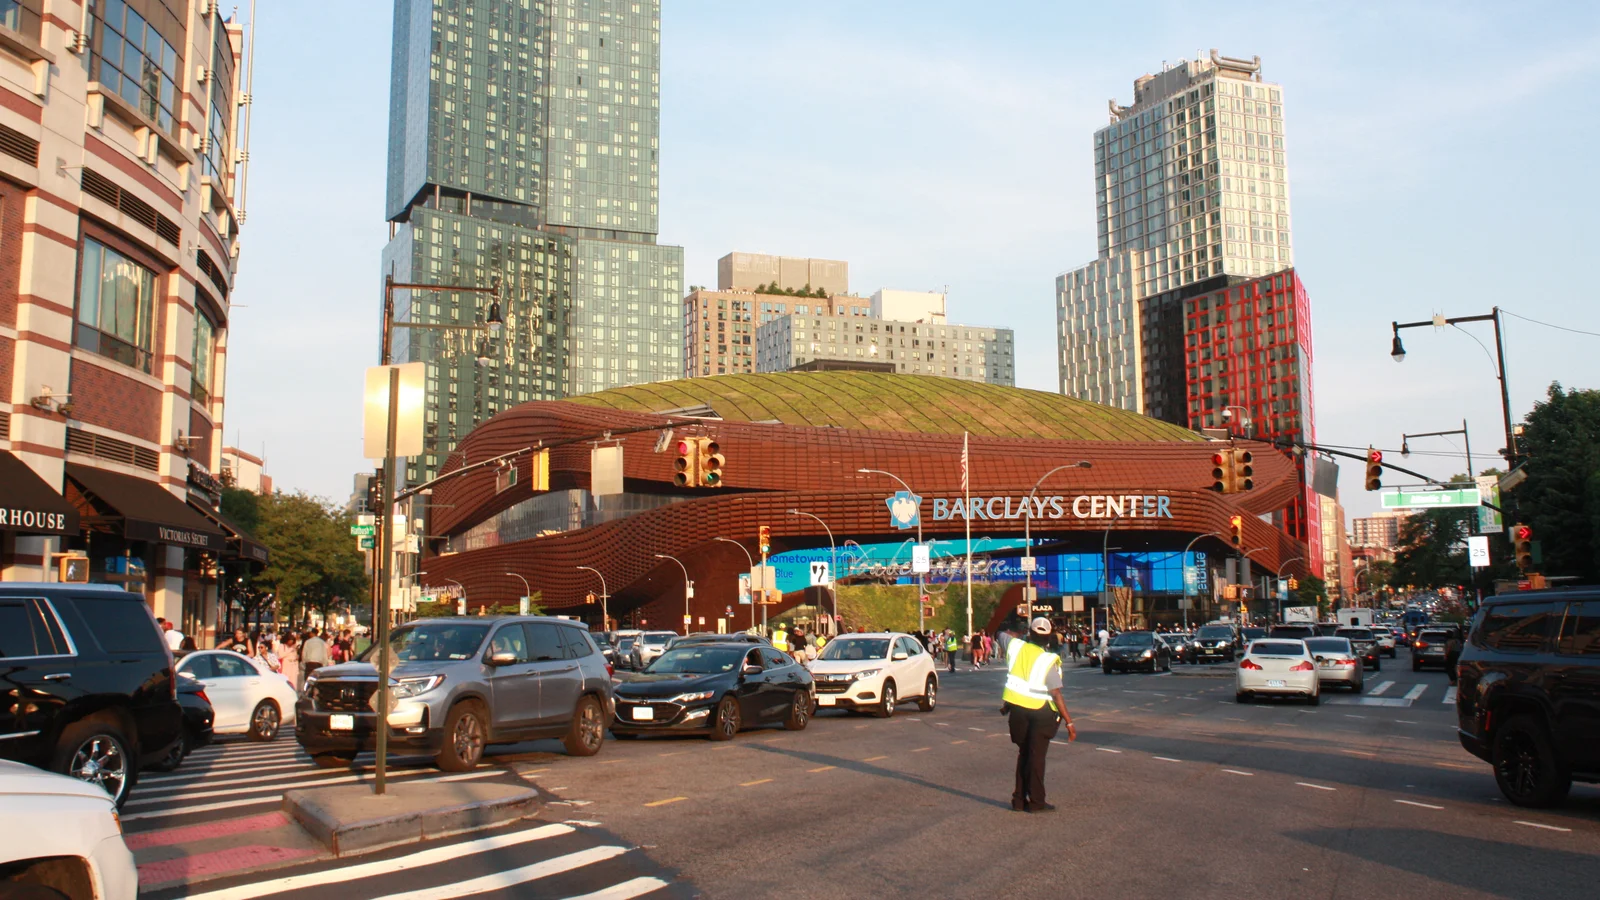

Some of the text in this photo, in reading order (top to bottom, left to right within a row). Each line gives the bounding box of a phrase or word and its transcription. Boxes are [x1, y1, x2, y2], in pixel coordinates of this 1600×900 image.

[933, 495, 1174, 520] BARCLAYS CENTER
[0, 508, 65, 530] RHOUSE
[159, 526, 209, 546] VICTORIA'S SECRET
[1472, 549, 1487, 557] 25
[1003, 563, 1047, 576] tea's
